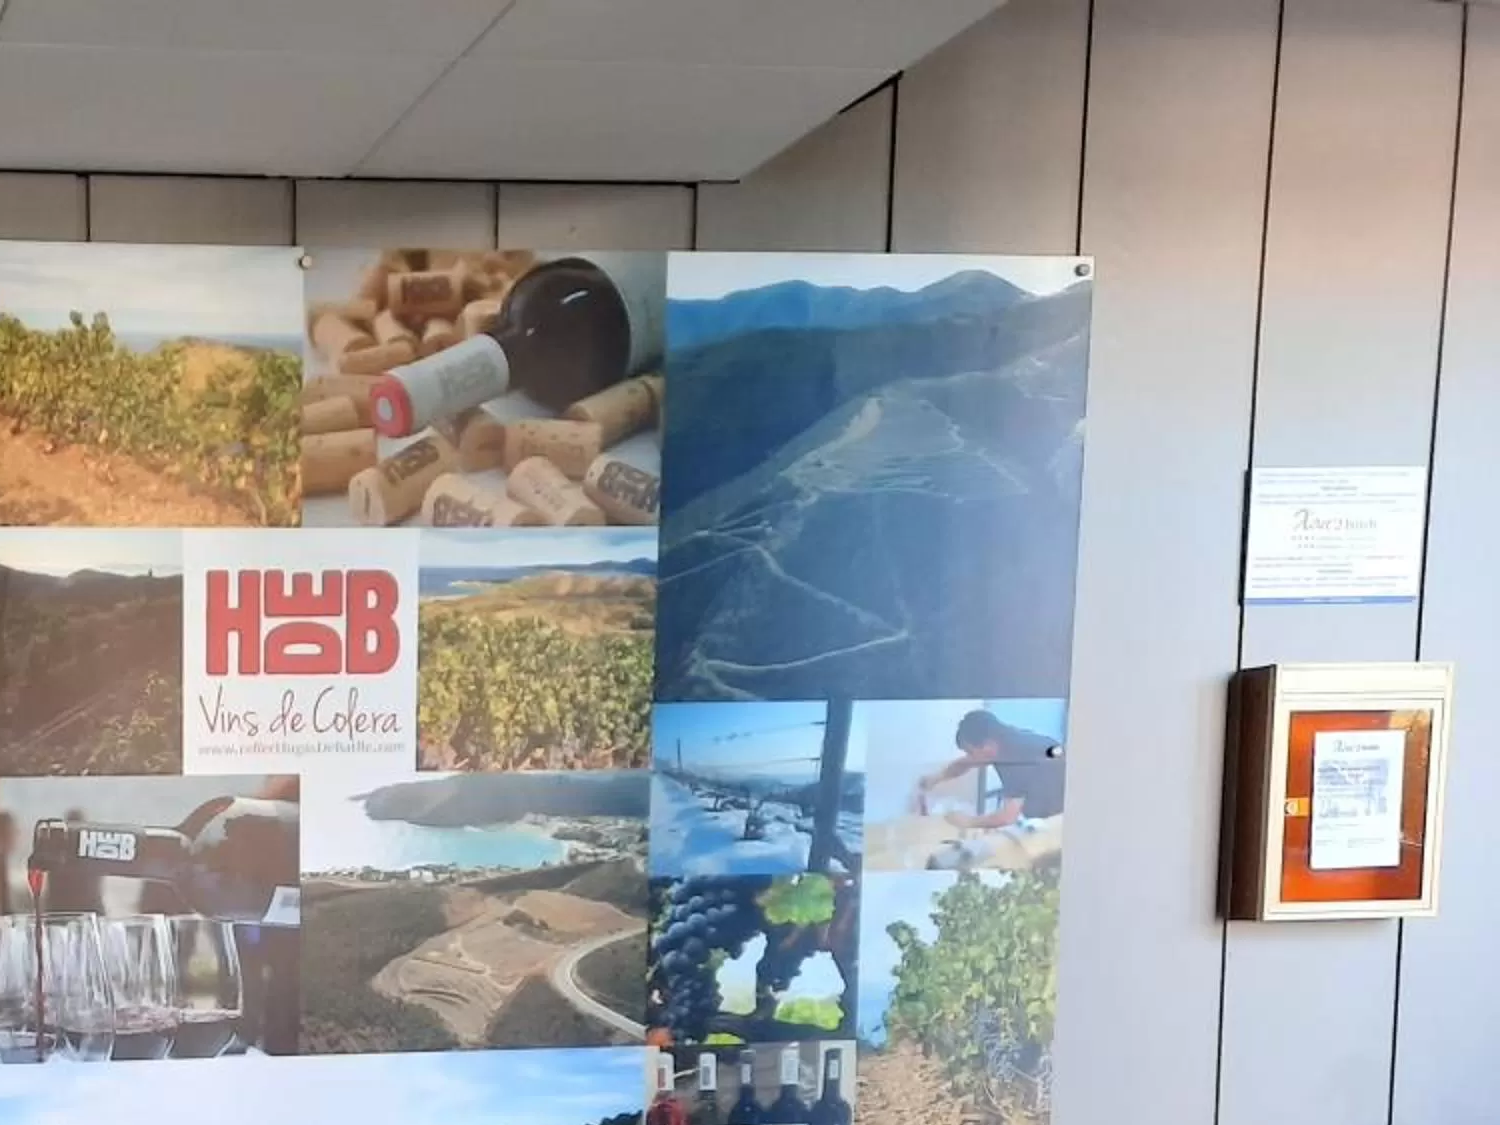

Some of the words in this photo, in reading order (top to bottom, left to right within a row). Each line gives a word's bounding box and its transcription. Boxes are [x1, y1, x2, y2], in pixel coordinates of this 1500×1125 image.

[199, 684, 259, 737] Vins
[269, 688, 306, 737] de
[312, 685, 402, 740] Colera
